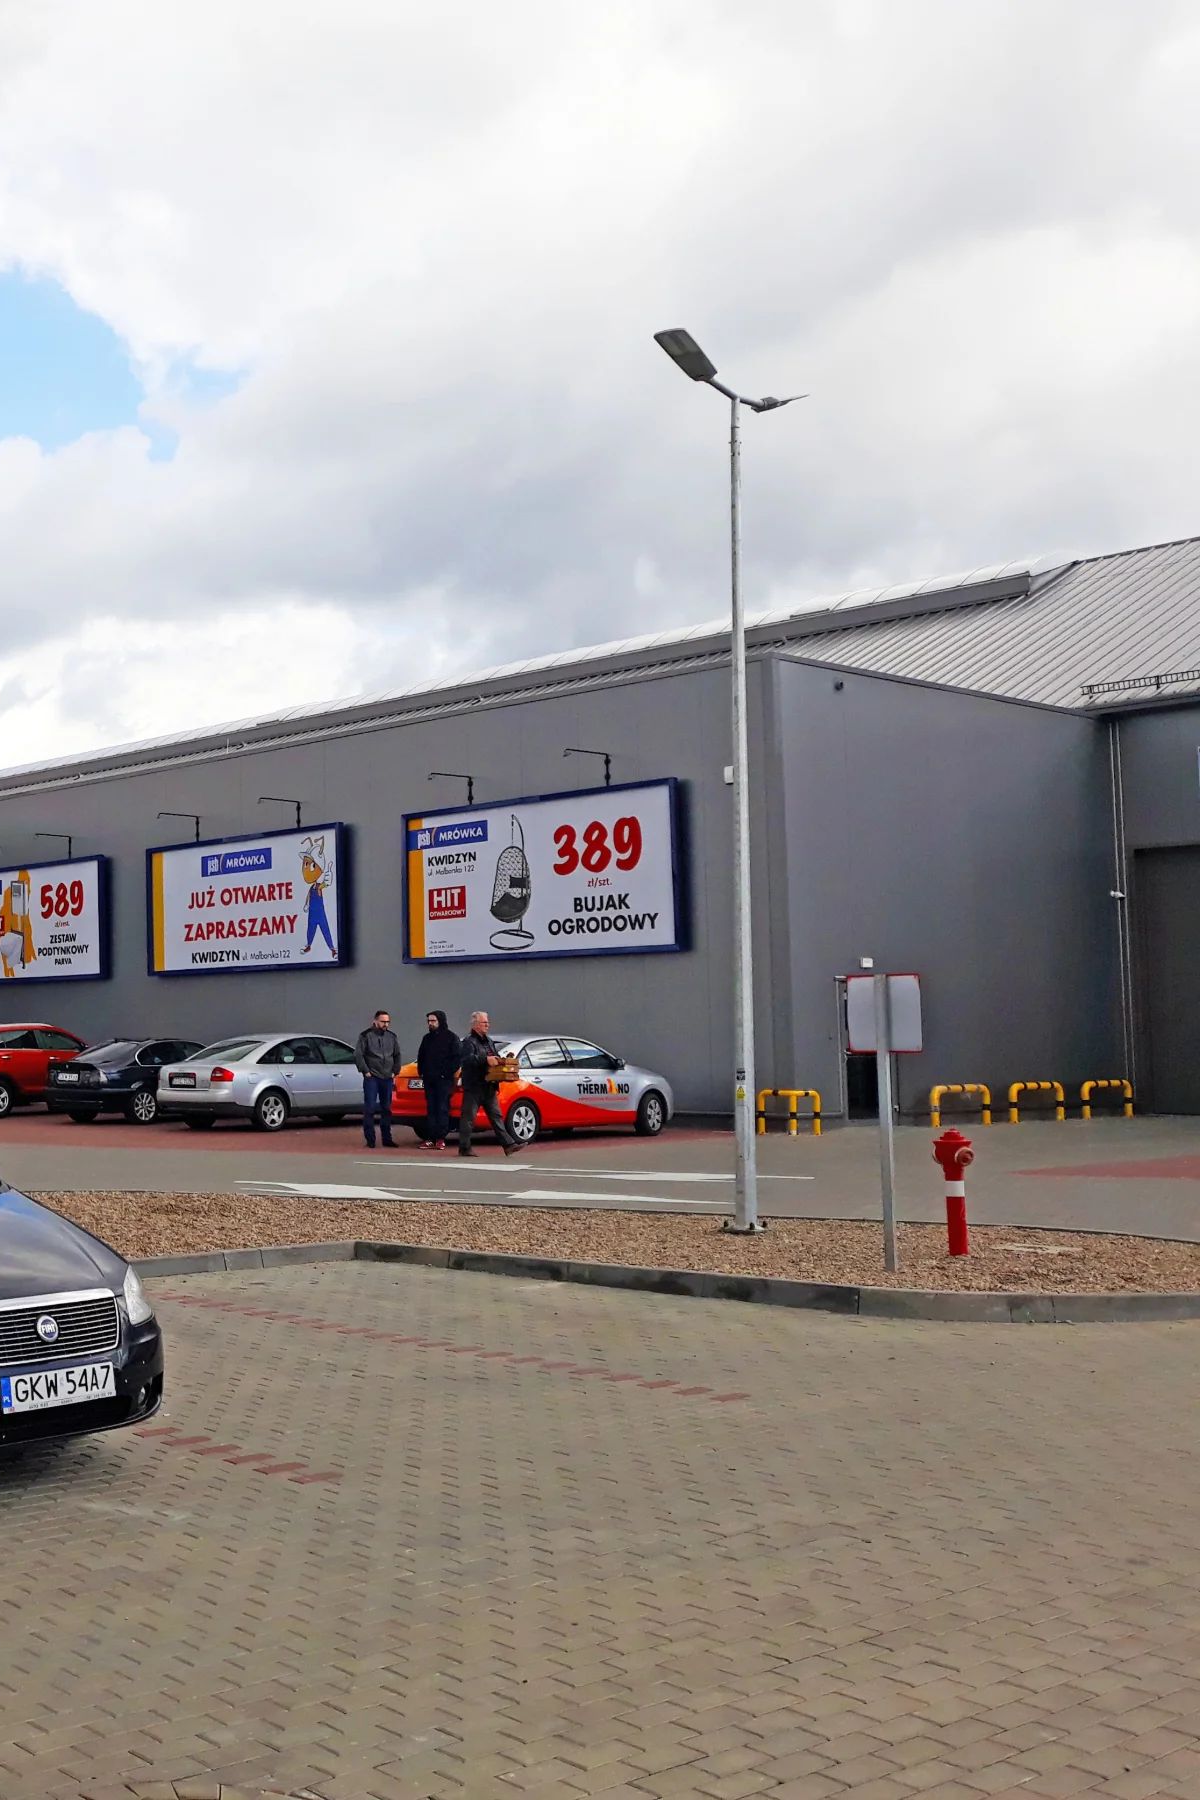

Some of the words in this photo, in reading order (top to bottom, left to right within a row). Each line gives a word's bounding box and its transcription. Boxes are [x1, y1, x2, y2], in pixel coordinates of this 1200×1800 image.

[439, 827, 483, 842] MRÓWKA
[553, 815, 642, 876] 389
[226, 854, 265, 869] MRÓWKA
[428, 852, 476, 867] KWIDZYN
[464, 865, 475, 873] 122
[40, 880, 84, 919] 589
[187, 885, 215, 910] JUŻ
[220, 882, 293, 906] OTWARTE
[433, 888, 460, 909] HIT
[573, 893, 631, 913] BUJAK
[184, 914, 298, 942] ZAPRASZAMY
[548, 912, 659, 935] OGRODOWY
[50, 933, 77, 944] ZESTAW
[38, 944, 89, 957] PODTYNKOWY
[191, 950, 240, 964] KWIDZYN
[41, 1323, 57, 1334] FIAT
[14, 1372, 59, 1403] GKW
[65, 1364, 111, 1395] 54A7
